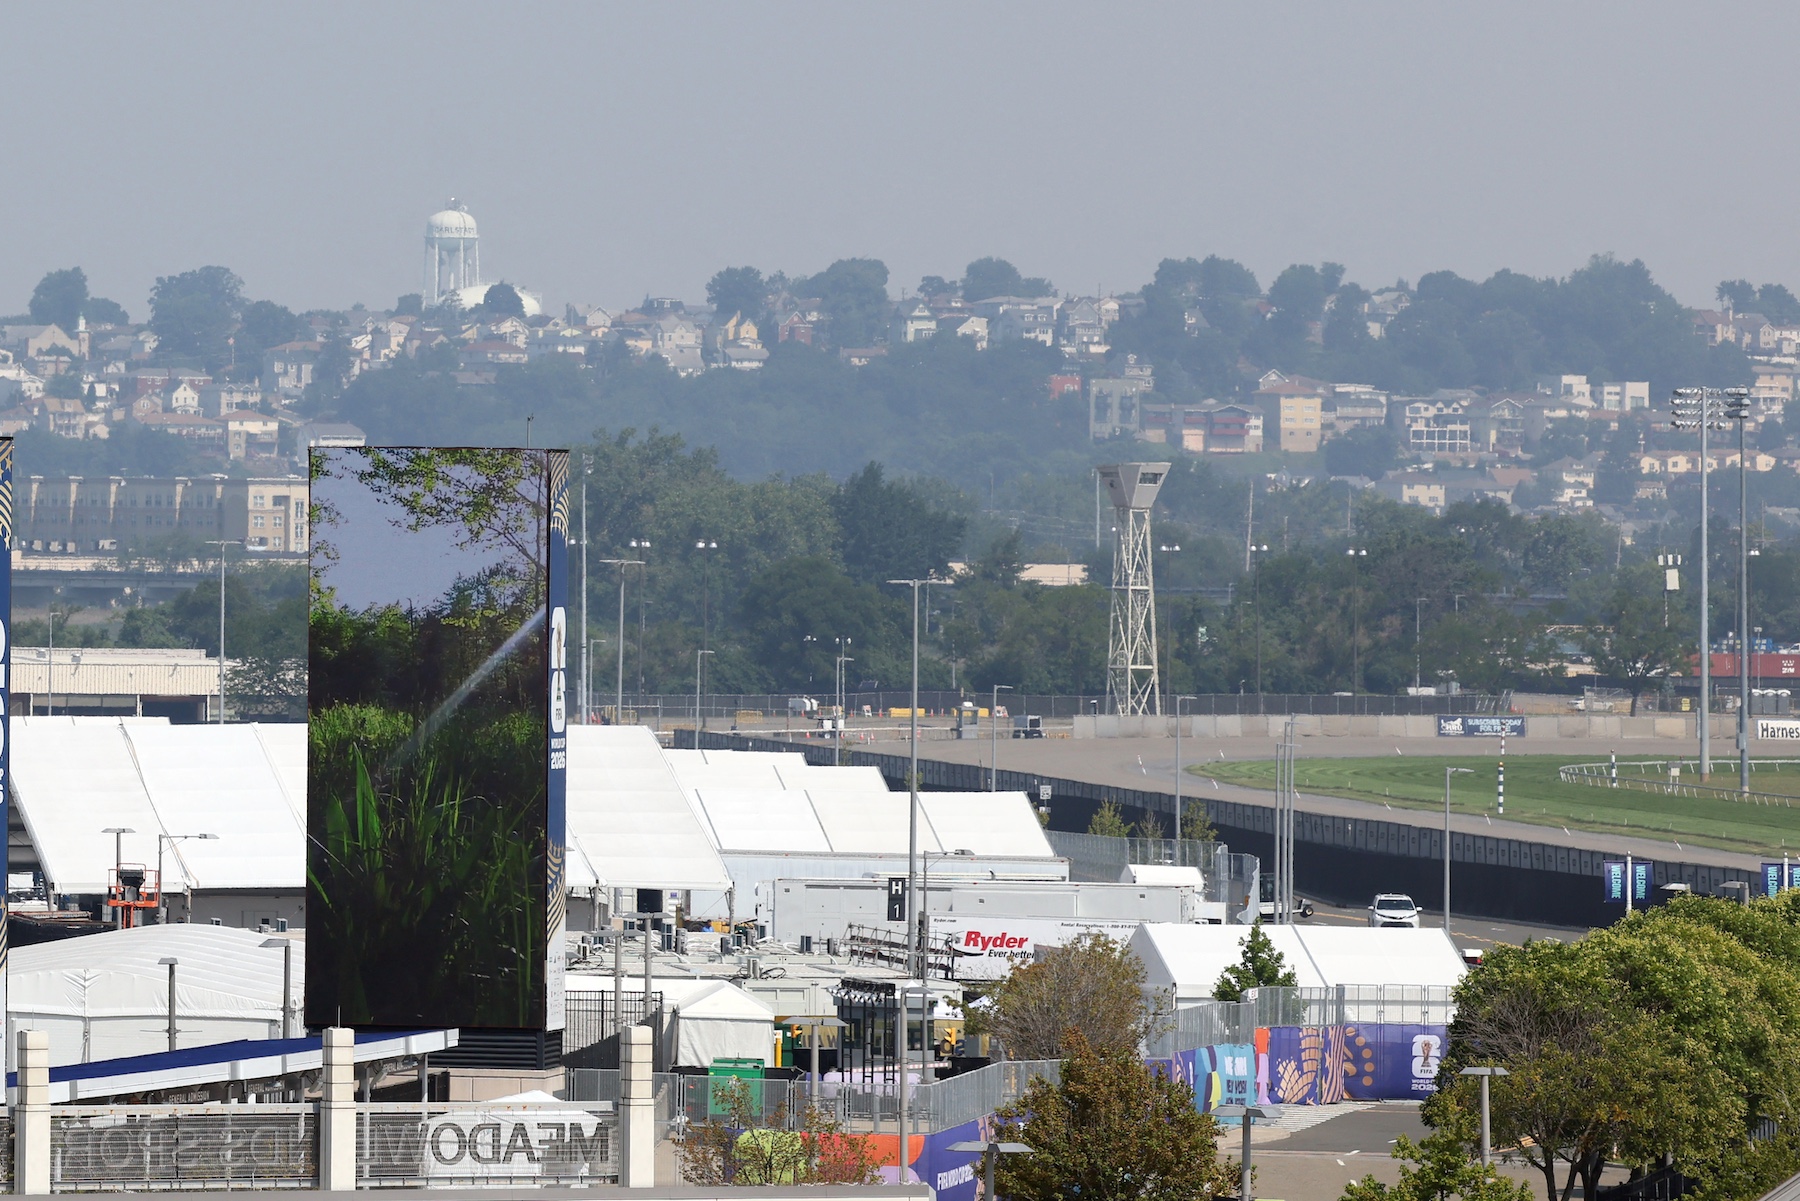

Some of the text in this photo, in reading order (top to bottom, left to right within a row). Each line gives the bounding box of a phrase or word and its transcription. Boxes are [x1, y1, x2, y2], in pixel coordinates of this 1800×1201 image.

[551, 751, 565, 770] 2026
[892, 881, 902, 894] H
[1611, 865, 1621, 899] WELCOME
[1636, 865, 1646, 899] WELCOME
[1767, 866, 1778, 897] WELCOM
[894, 904, 899, 918] 1
[964, 931, 1028, 950] Ryder
[988, 949, 1007, 958] Ever
[169, 1090, 210, 1104] GENERAL ADMISSION
